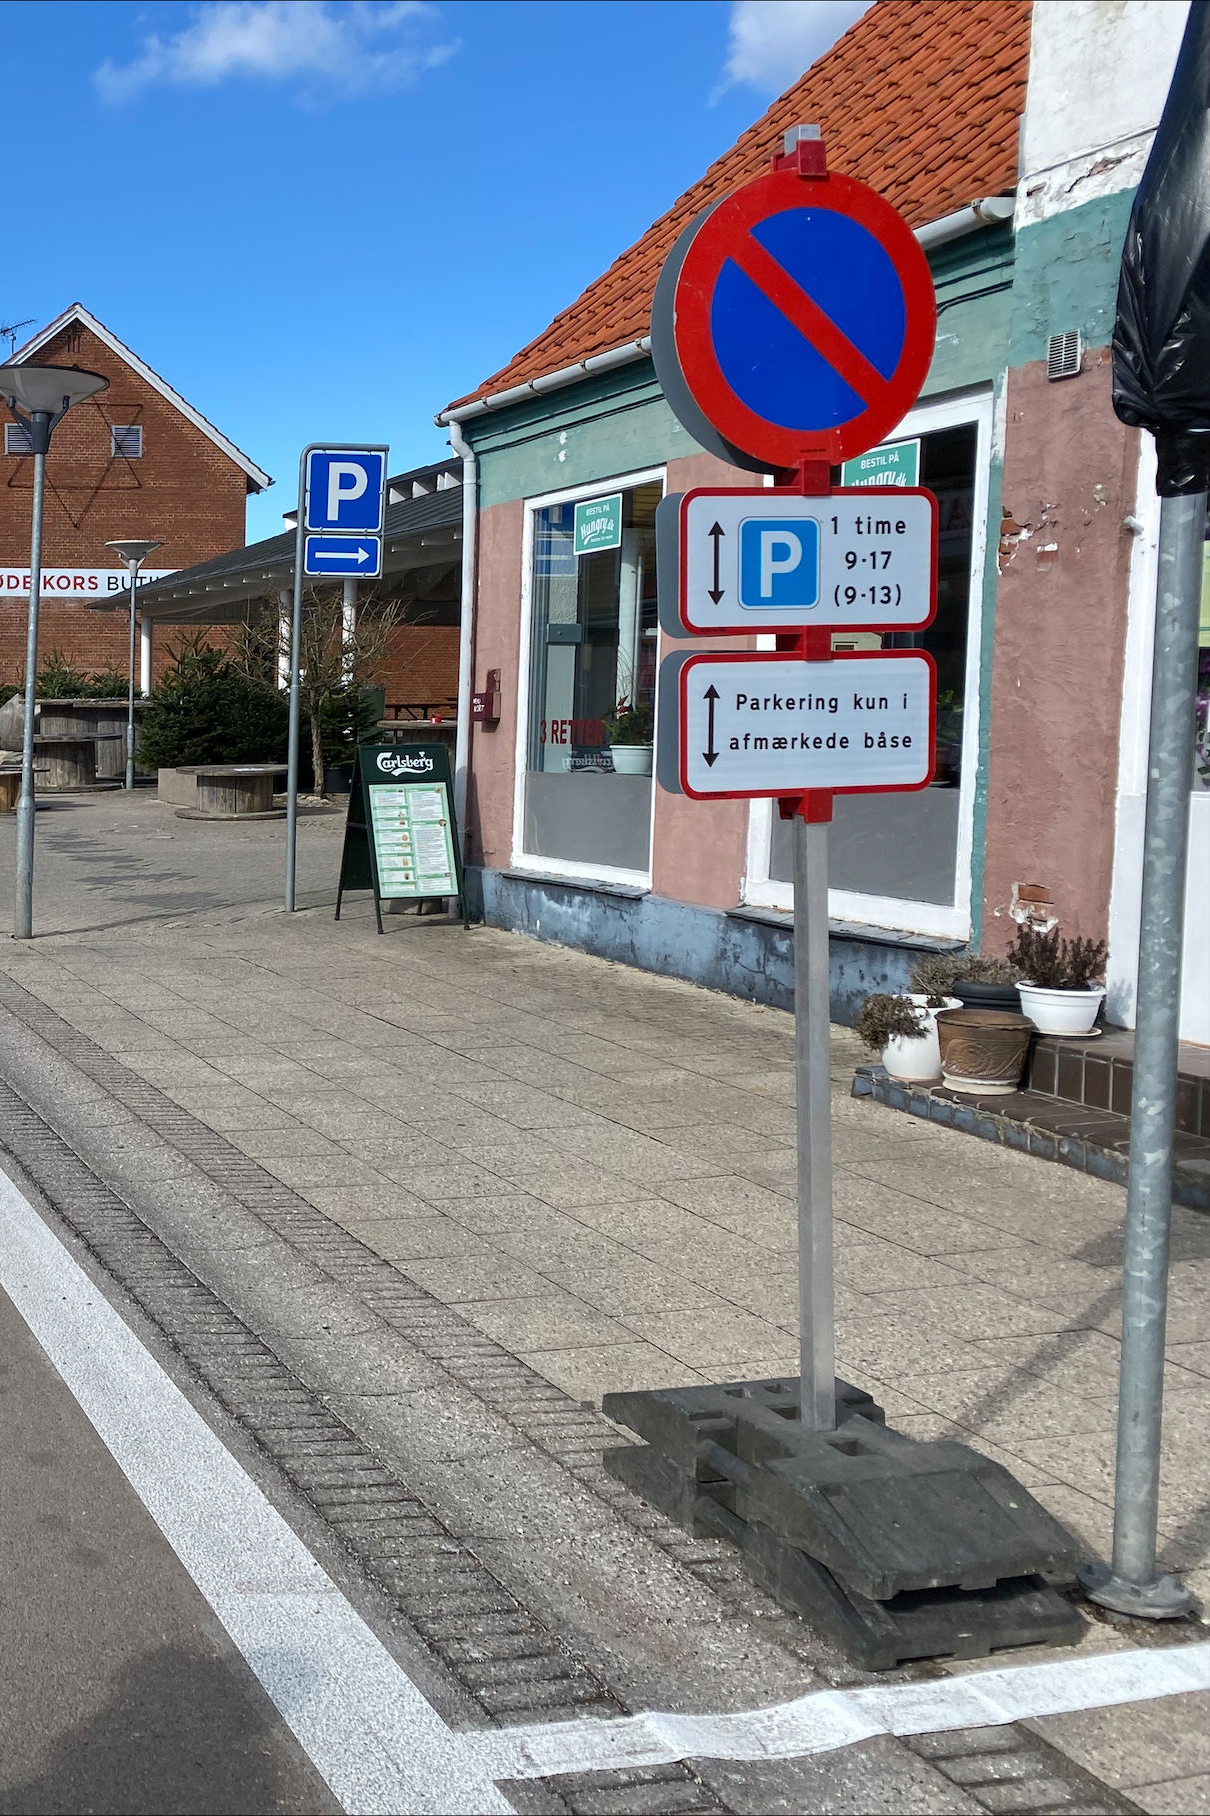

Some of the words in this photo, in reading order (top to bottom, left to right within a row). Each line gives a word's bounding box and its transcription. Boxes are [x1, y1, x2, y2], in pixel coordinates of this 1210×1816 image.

[860, 455, 887, 469] BESTIL
[889, 451, 900, 464] PÅ
[327, 462, 368, 521] P
[586, 506, 603, 517] BESTIL
[603, 502, 611, 512] PÅ
[580, 517, 614, 542] Hungry.dk
[831, 516, 838, 535] 1
[855, 516, 906, 535] time
[760, 530, 803, 598] P
[845, 551, 892, 570] 9-17
[43, 575, 99, 591] KORS
[834, 584, 902, 607] (9-13)
[736, 694, 839, 713] Parkering
[854, 693, 889, 710] kun
[903, 693, 908, 710] i
[540, 719, 547, 745] 3
[729, 733, 850, 751] afmærkede
[864, 732, 912, 749] båse
[376, 751, 433, 773] Carlsberg
